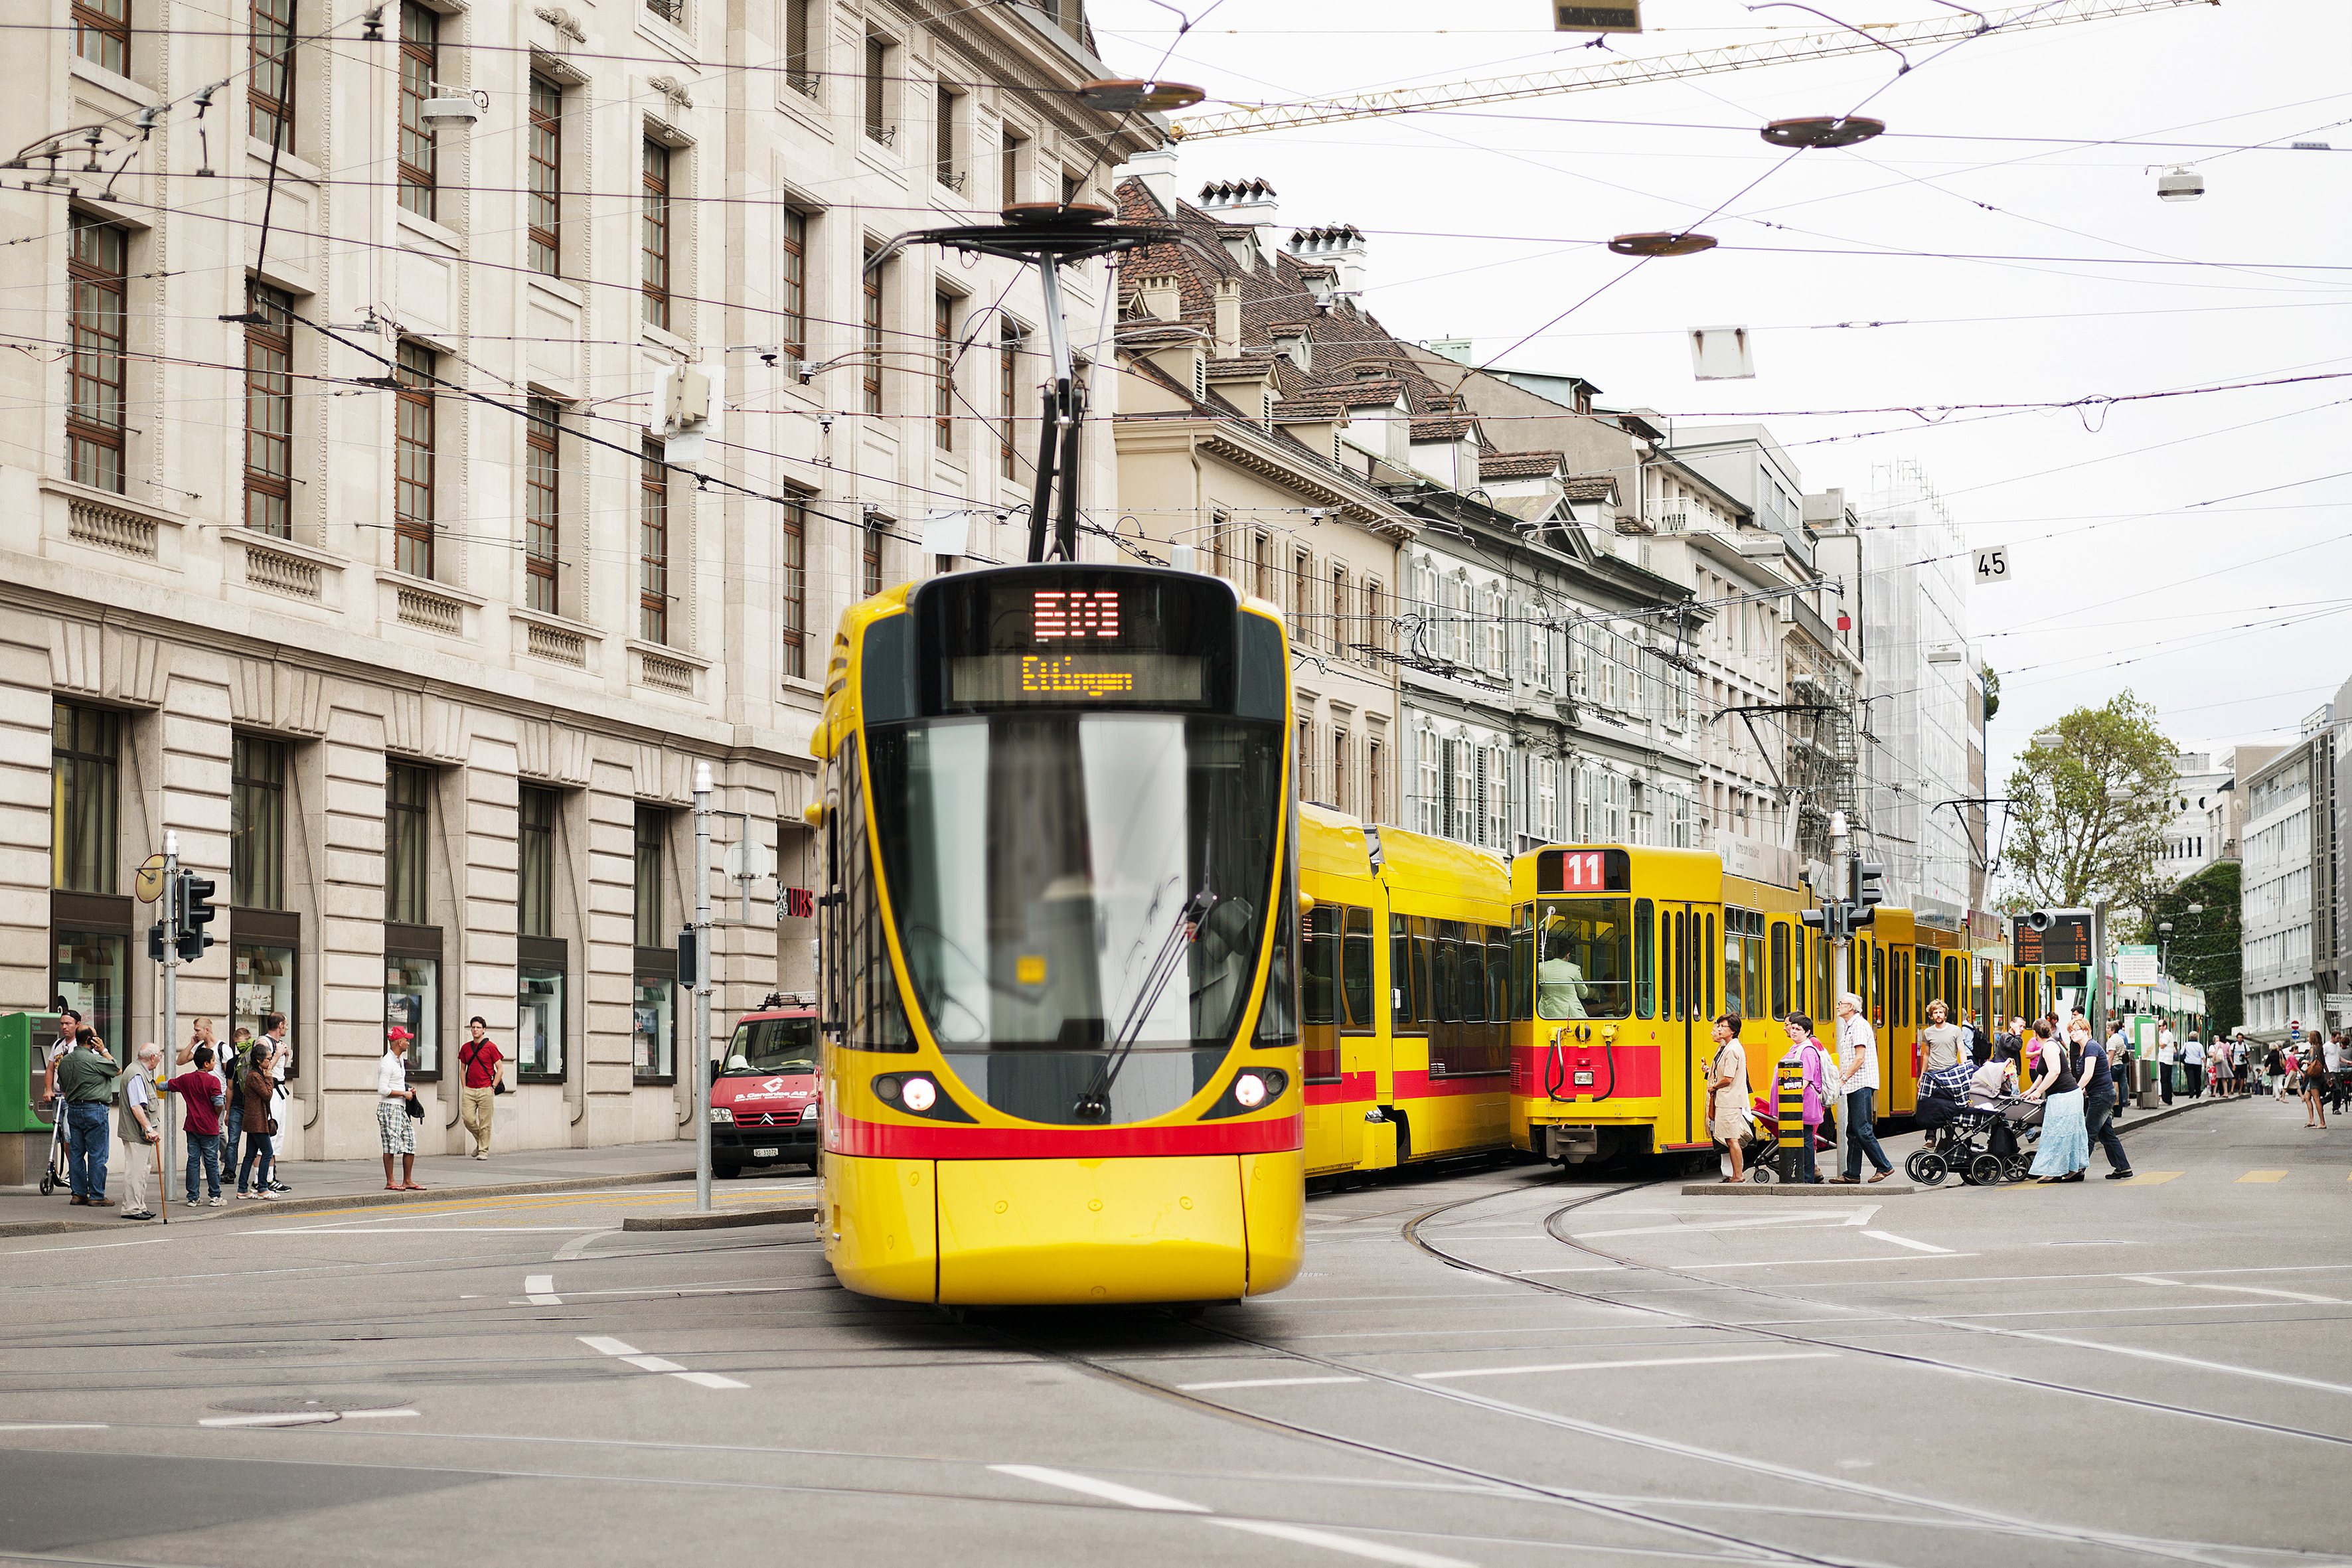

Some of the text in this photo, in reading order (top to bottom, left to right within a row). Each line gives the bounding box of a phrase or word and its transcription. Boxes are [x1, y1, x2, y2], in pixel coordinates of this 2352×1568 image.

[1978, 552, 2006, 577] 45
[1568, 854, 1599, 886] 11
[790, 888, 814, 918] UBS
[59, 949, 70, 958] UBS
[238, 961, 247, 970] UBS
